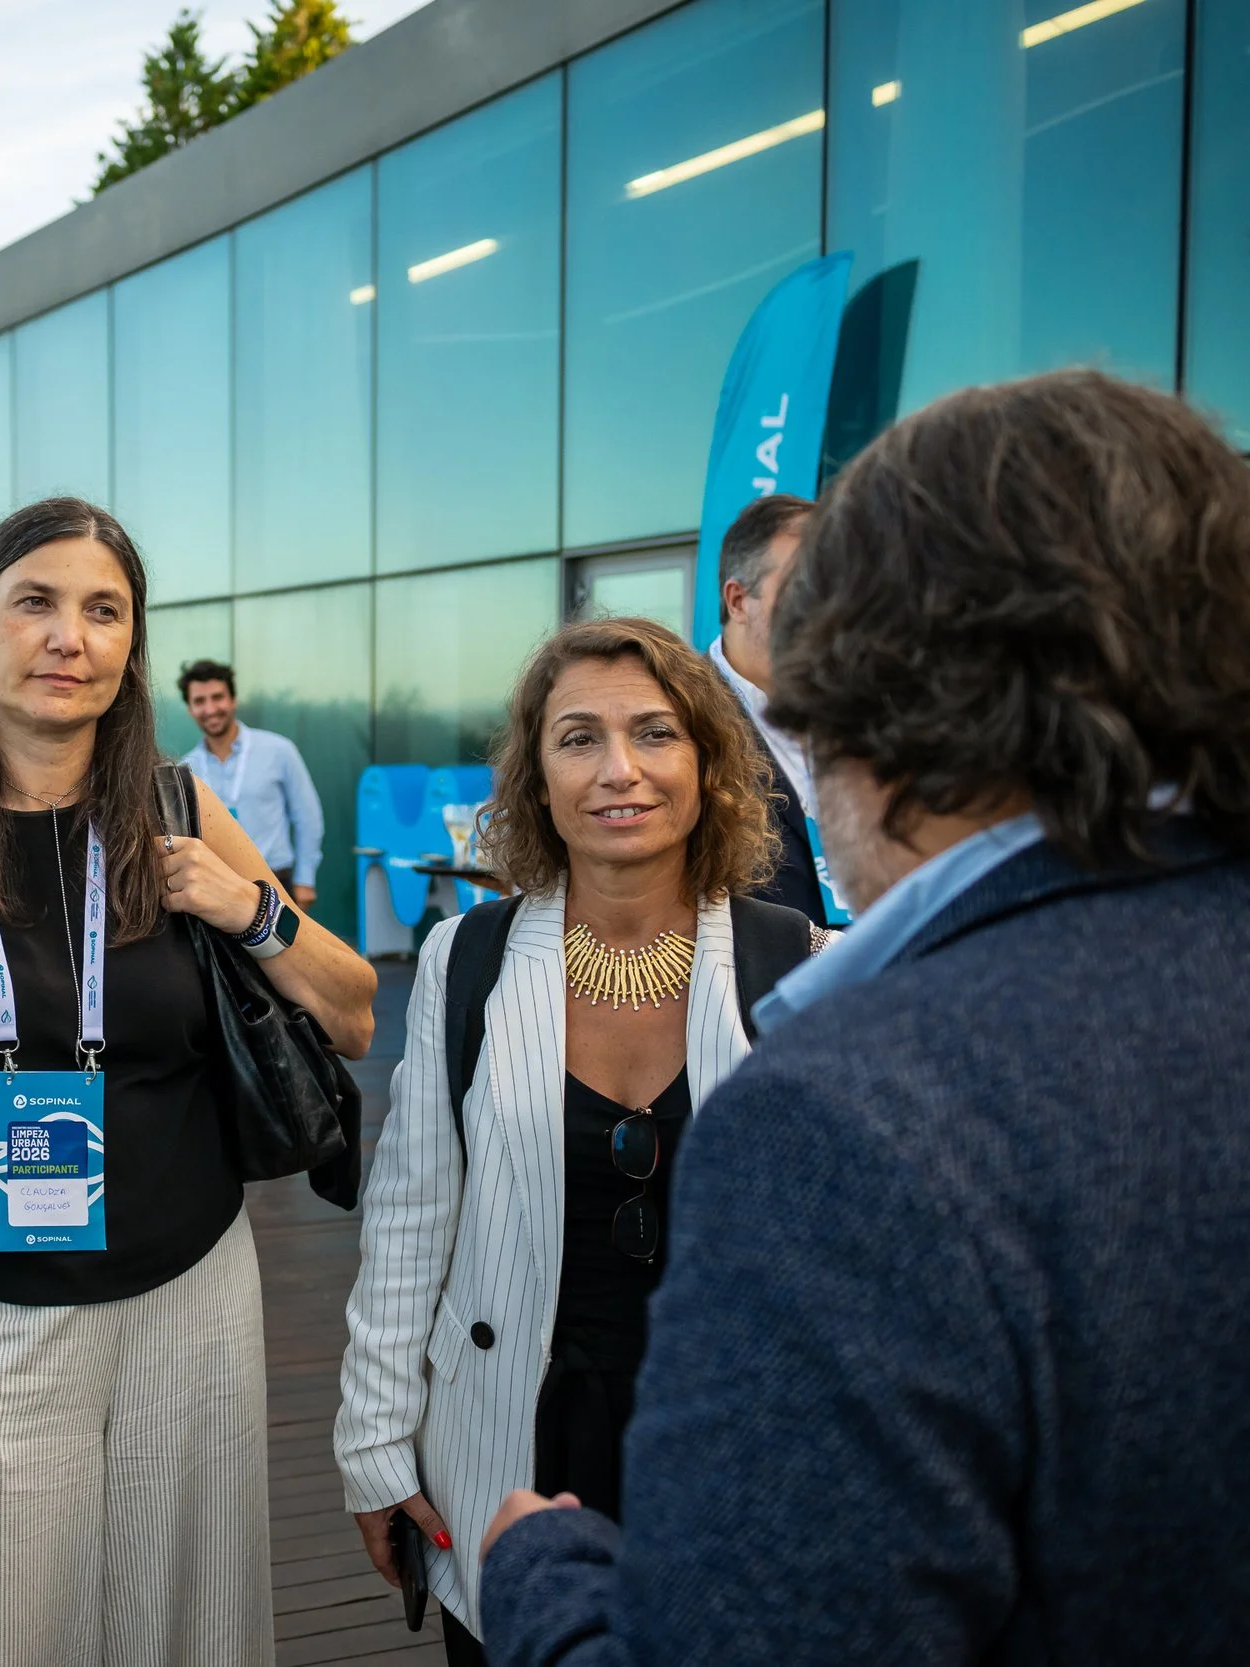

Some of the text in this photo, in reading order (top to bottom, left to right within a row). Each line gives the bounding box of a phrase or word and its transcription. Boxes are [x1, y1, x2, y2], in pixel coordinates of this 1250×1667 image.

[247, 924, 270, 944] CONTE
[0, 972, 7, 998] SOPINAL
[29, 1097, 81, 1106] SOPINAL
[11, 1130, 50, 1138] LIMPEZA
[11, 1138, 50, 1147] URBANA
[11, 1147, 50, 1161] 2026
[12, 1165, 79, 1174] PARTICIPANTE
